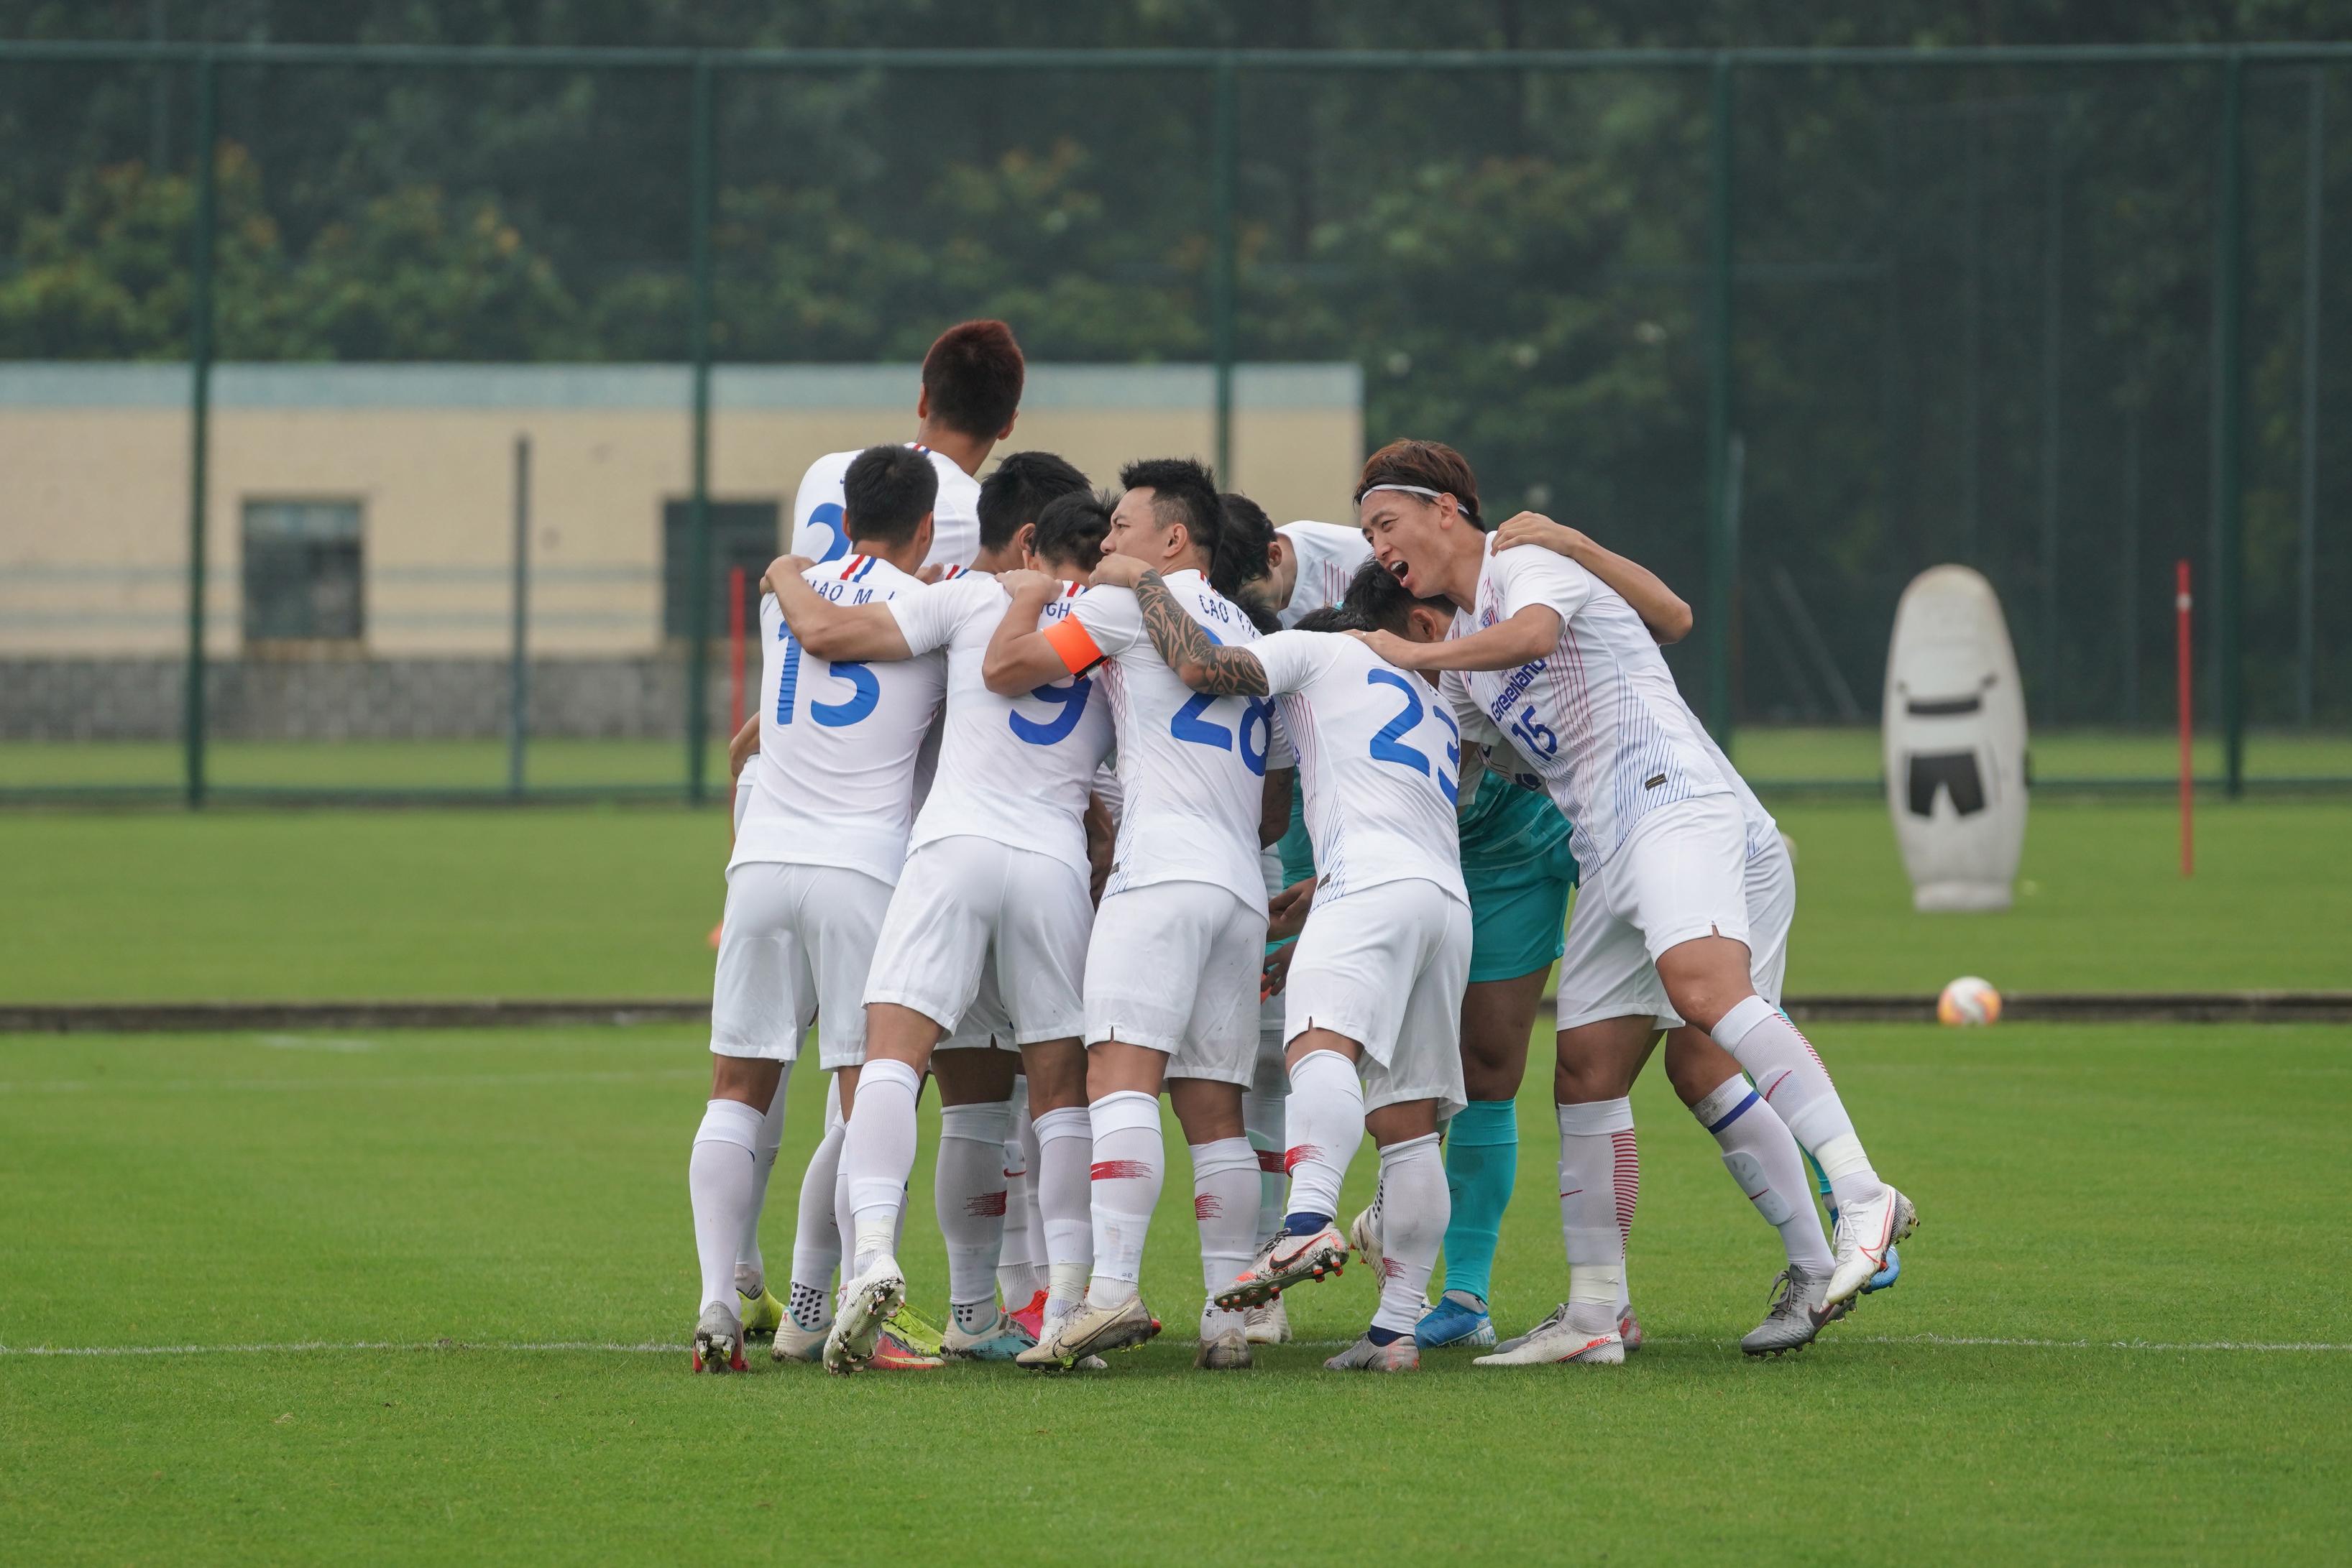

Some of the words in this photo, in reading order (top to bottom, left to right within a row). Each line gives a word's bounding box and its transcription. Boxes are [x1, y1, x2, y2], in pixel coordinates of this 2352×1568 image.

[1198, 594, 1229, 624] CAO
[1367, 668, 1461, 811] 23
[1511, 705, 1558, 762] 15
